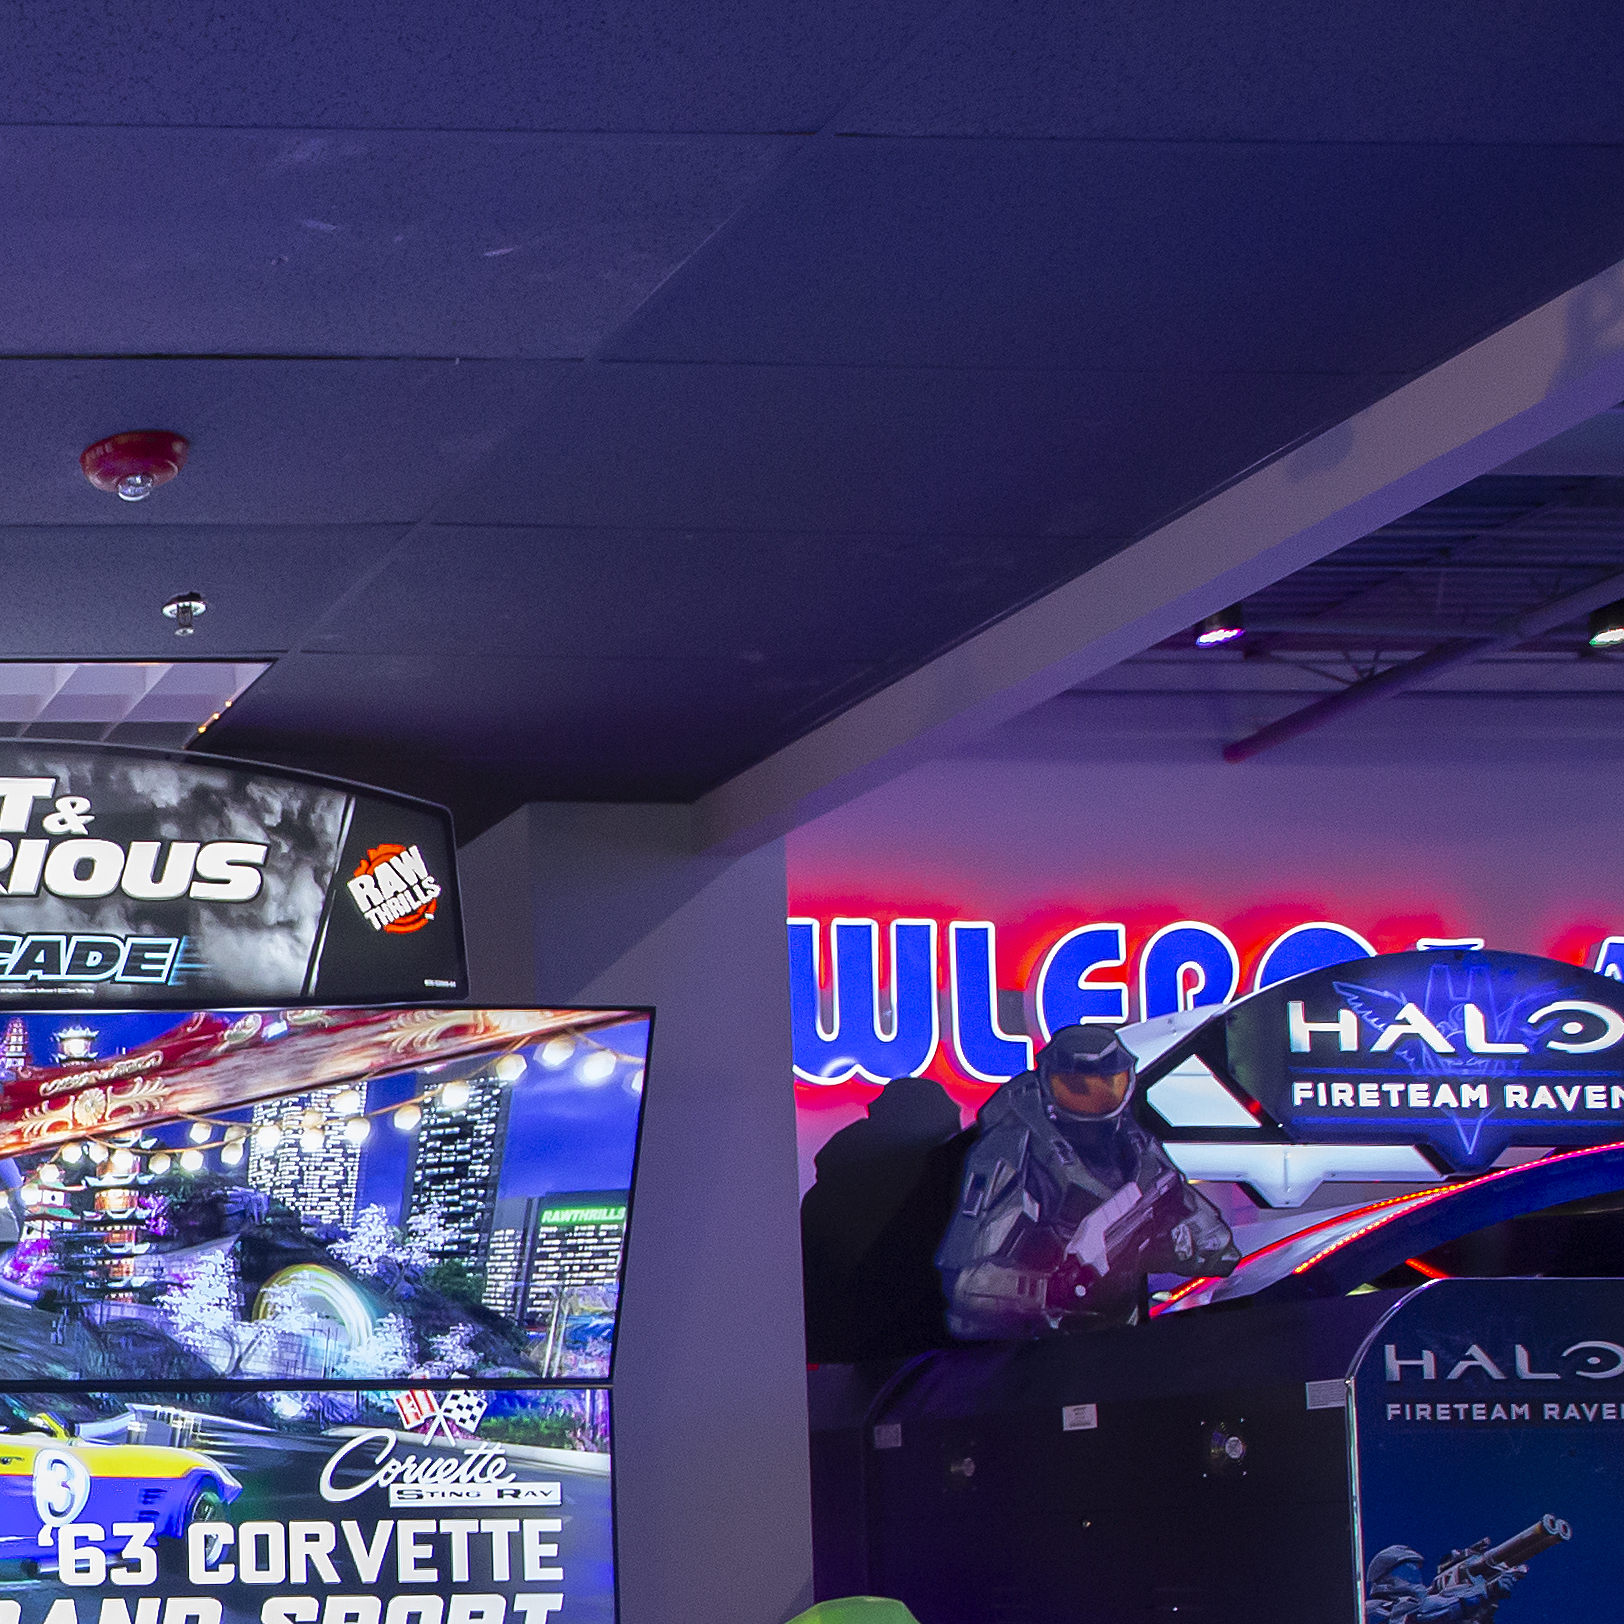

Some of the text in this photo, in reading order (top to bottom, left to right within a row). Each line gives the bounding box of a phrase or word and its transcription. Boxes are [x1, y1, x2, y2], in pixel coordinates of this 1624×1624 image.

[42, 796, 94, 834] &
[347, 844, 428, 912] RAW
[364, 876, 441, 930] THRILLS
[1287, 1000, 1624, 1053] HALO
[1292, 1082, 1489, 1109] FIRETEAM
[1384, 1341, 1624, 1381] HALO
[1387, 1403, 1624, 1422] FIRETEAM RAVE
[42, 1457, 78, 1513] 3
[319, 1429, 517, 1501] Corvette
[187, 1519, 563, 1586] CORVETTE
